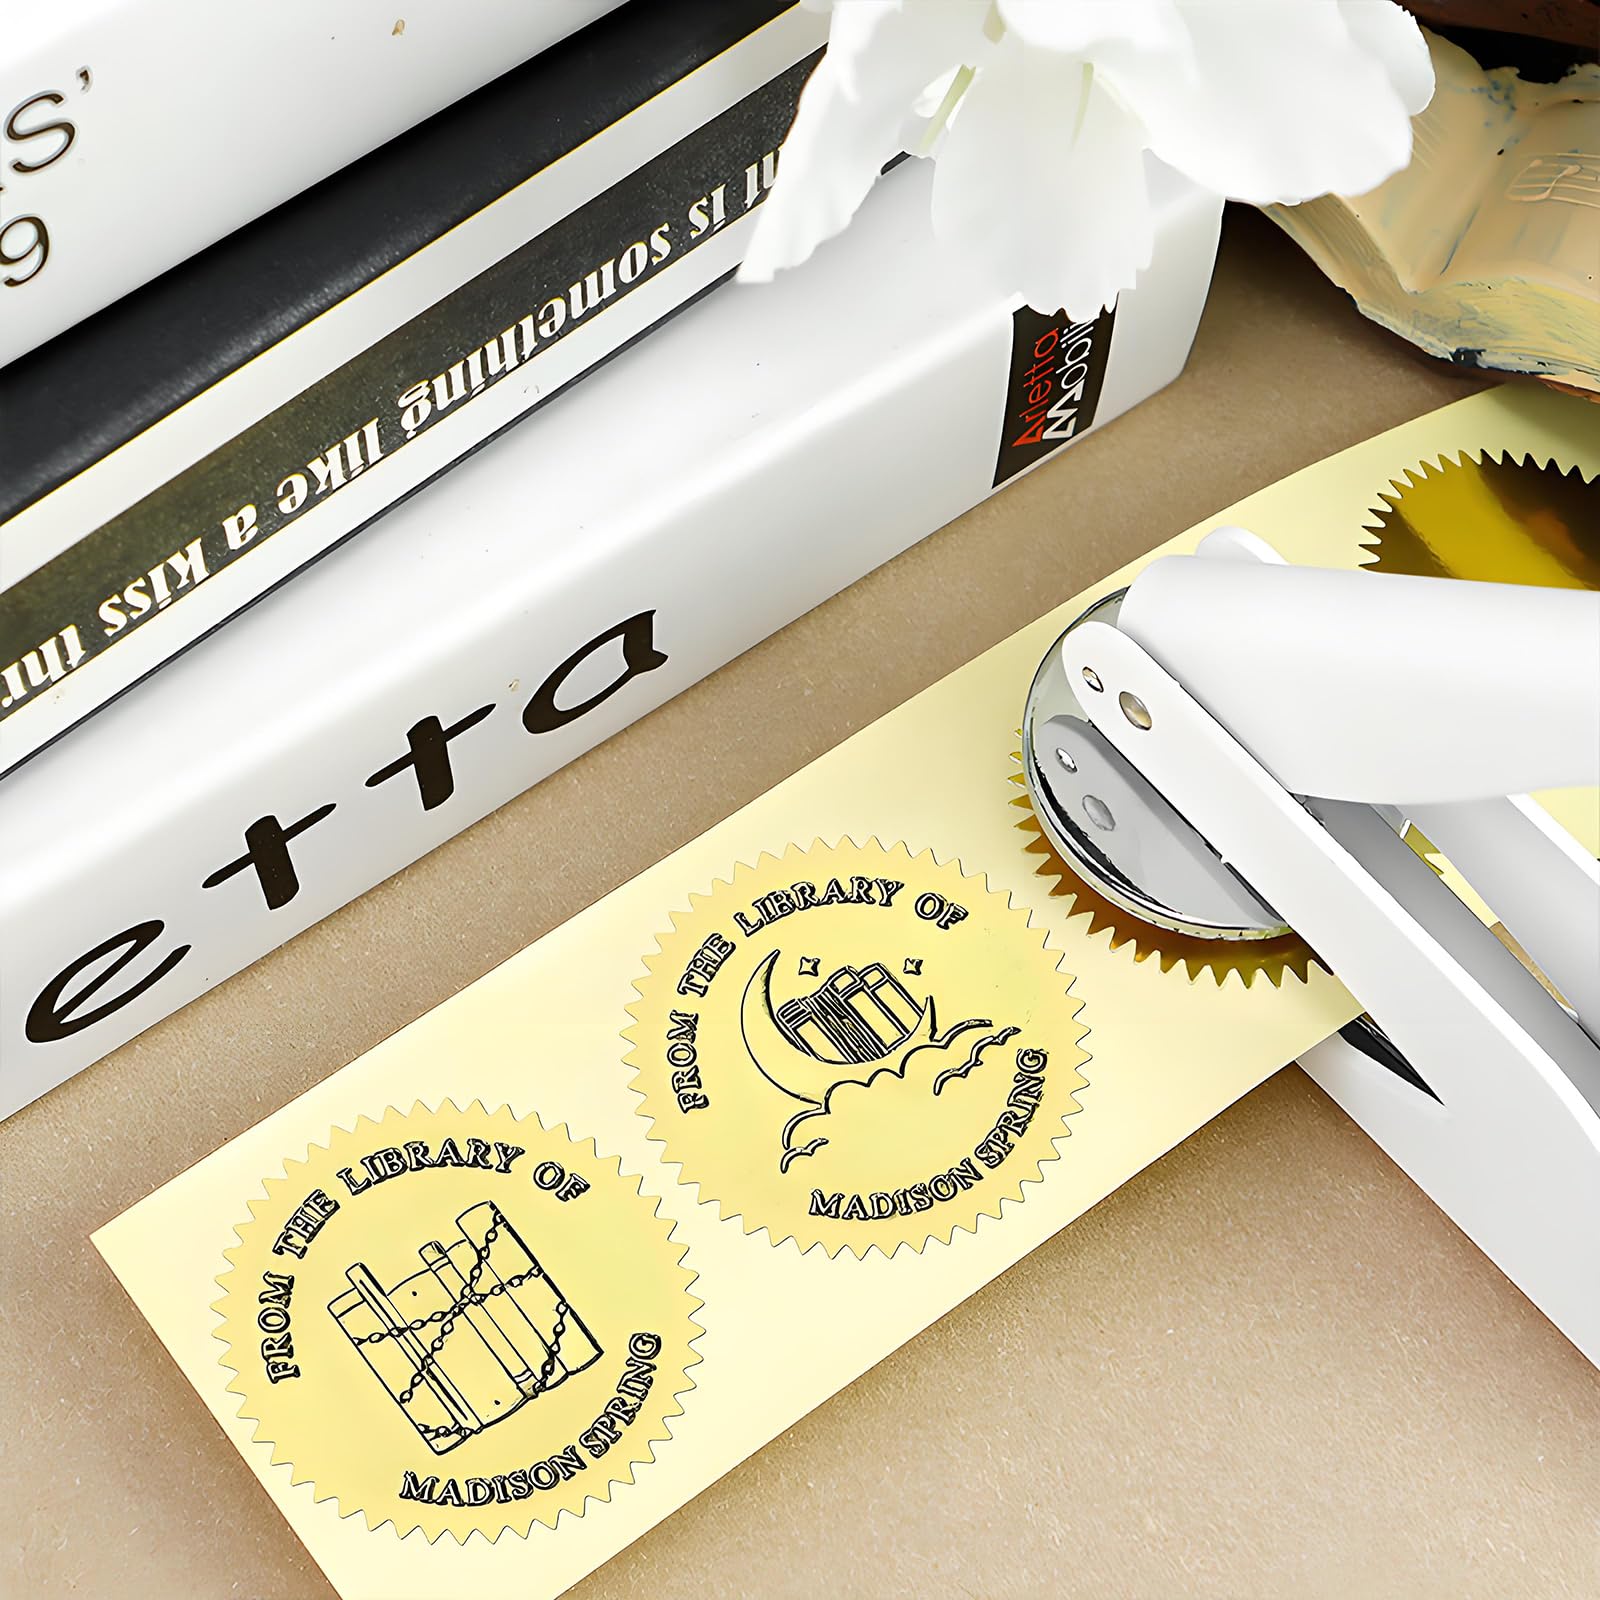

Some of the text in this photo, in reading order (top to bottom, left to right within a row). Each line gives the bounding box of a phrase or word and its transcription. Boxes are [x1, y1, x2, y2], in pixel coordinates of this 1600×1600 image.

[688, 184, 726, 239] is
[398, 223, 671, 439] something
[1012, 328, 1059, 447] Arletta
[222, 504, 258, 550] a
[276, 417, 384, 514] like
[99, 537, 210, 637] kiss
[667, 876, 969, 1113] FROM THE LIBRARY OF
[808, 1048, 1049, 1222] MADISON SPRING
[258, 1138, 590, 1384] FROM THE LIBRARY OF
[399, 1332, 662, 1507] MADISON SPRING
